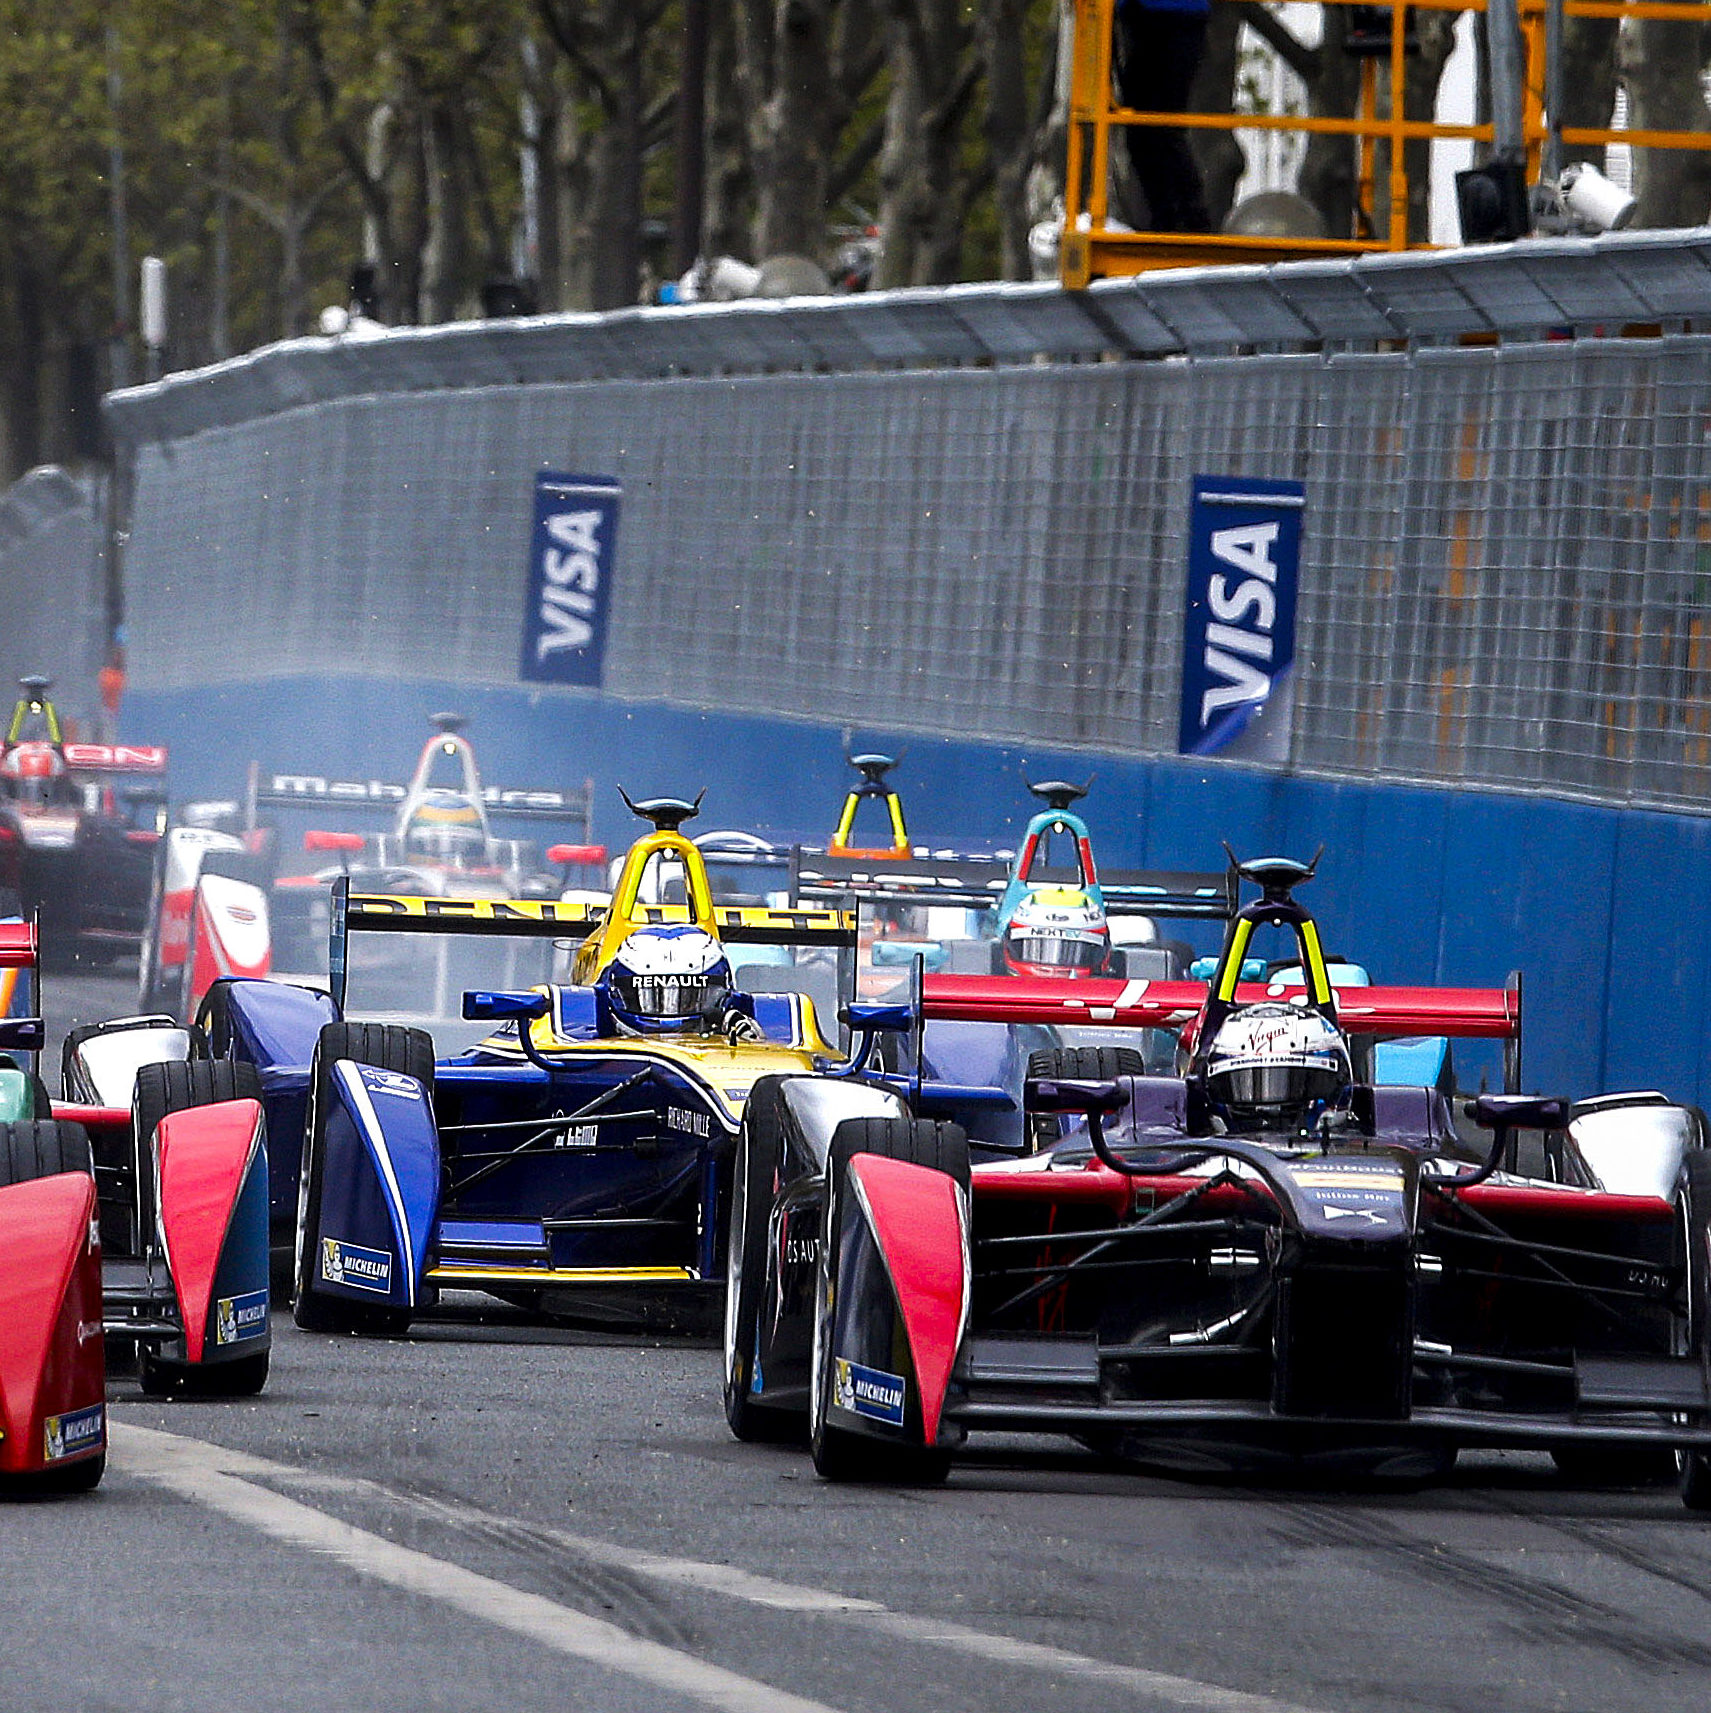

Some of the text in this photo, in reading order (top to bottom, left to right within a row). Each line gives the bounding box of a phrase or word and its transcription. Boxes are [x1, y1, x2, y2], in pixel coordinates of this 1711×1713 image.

[537, 510, 604, 661] VISA
[1200, 521, 1281, 729] VISA
[1030, 927, 1082, 938] NEXTEV
[632, 975, 709, 988] RENAULT
[1248, 1020, 1289, 1053] Virgin
[344, 1255, 389, 1278] MICHELIN
[855, 1379, 903, 1407] MICHELIN
